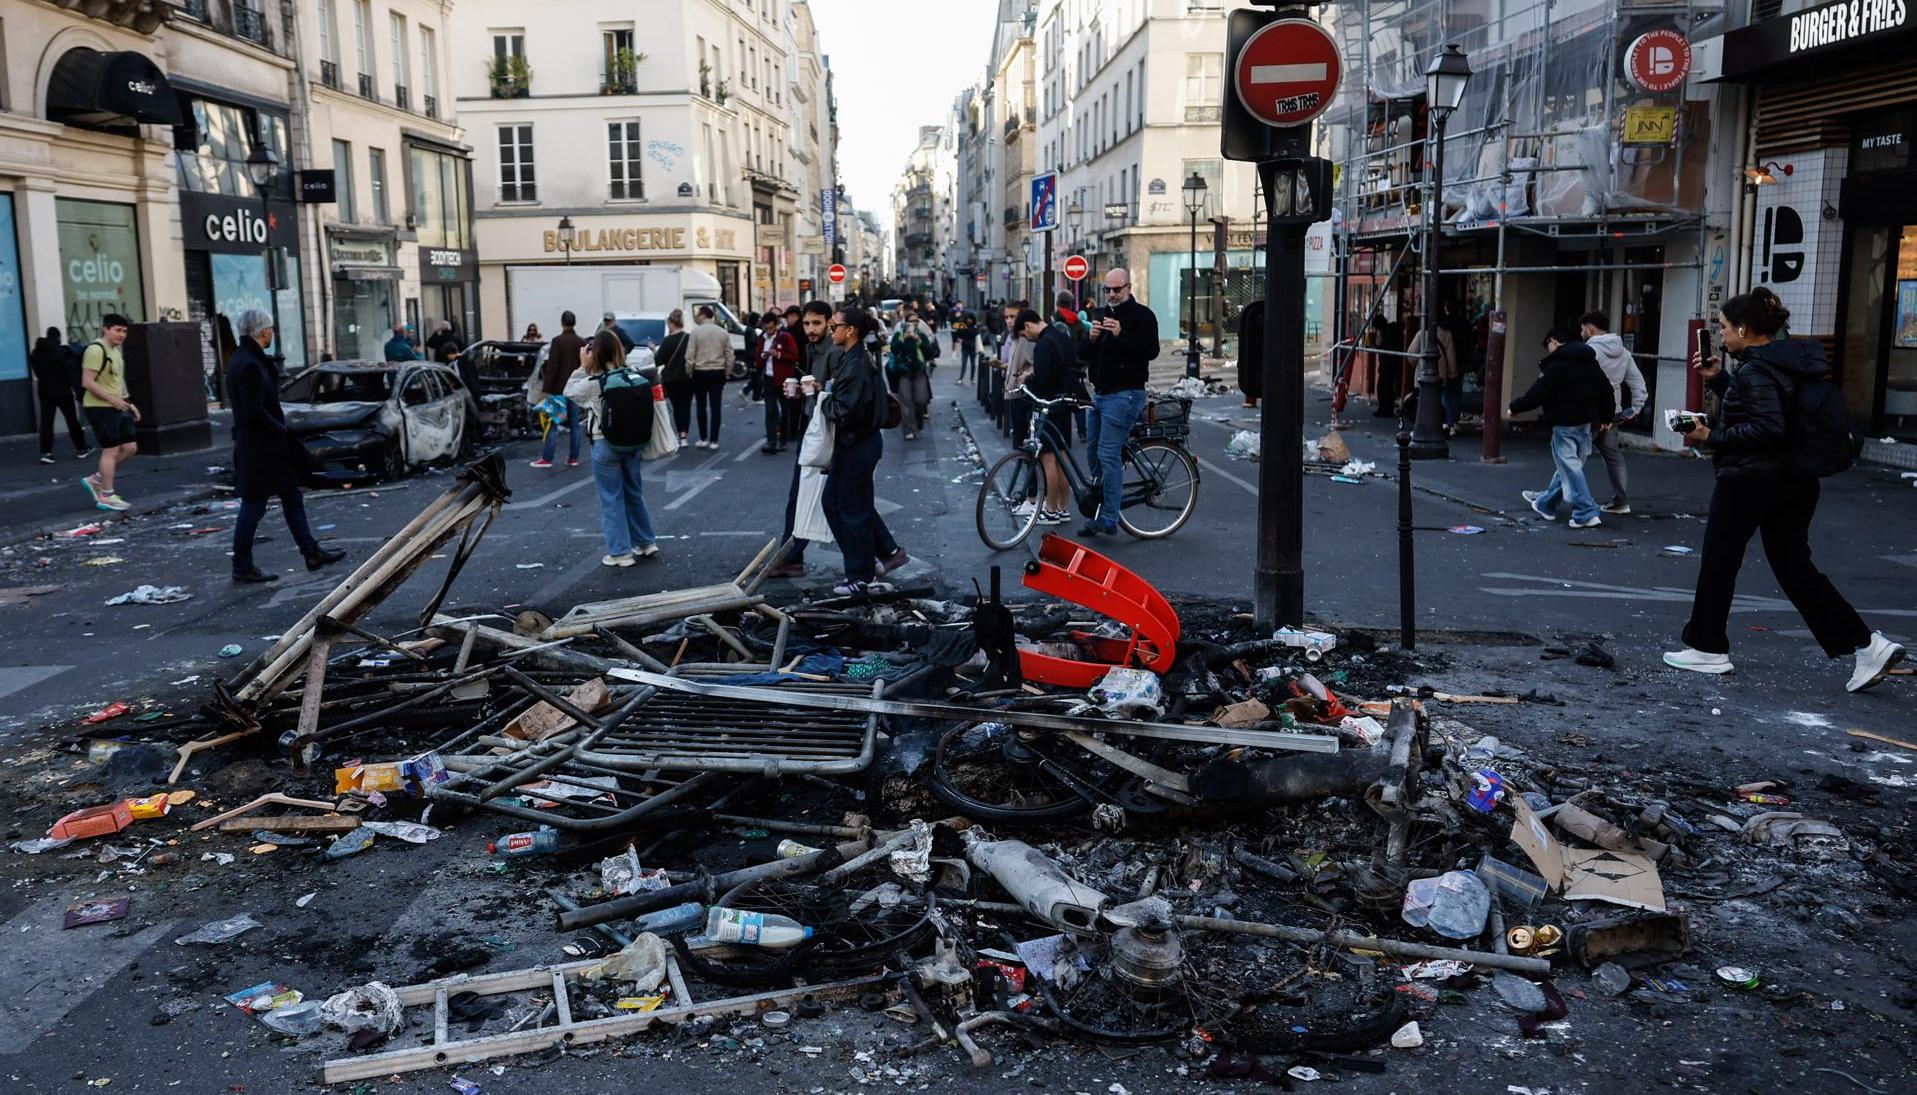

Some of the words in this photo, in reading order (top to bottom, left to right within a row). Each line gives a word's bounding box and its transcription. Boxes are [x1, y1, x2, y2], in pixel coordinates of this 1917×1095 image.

[1789, 3, 1848, 53] BURGER
[1847, 0, 1860, 38] &
[1862, 139, 1875, 149] MY
[1876, 133, 1902, 147] TASTE
[697, 227, 709, 249] &
[69, 253, 124, 283] celio
